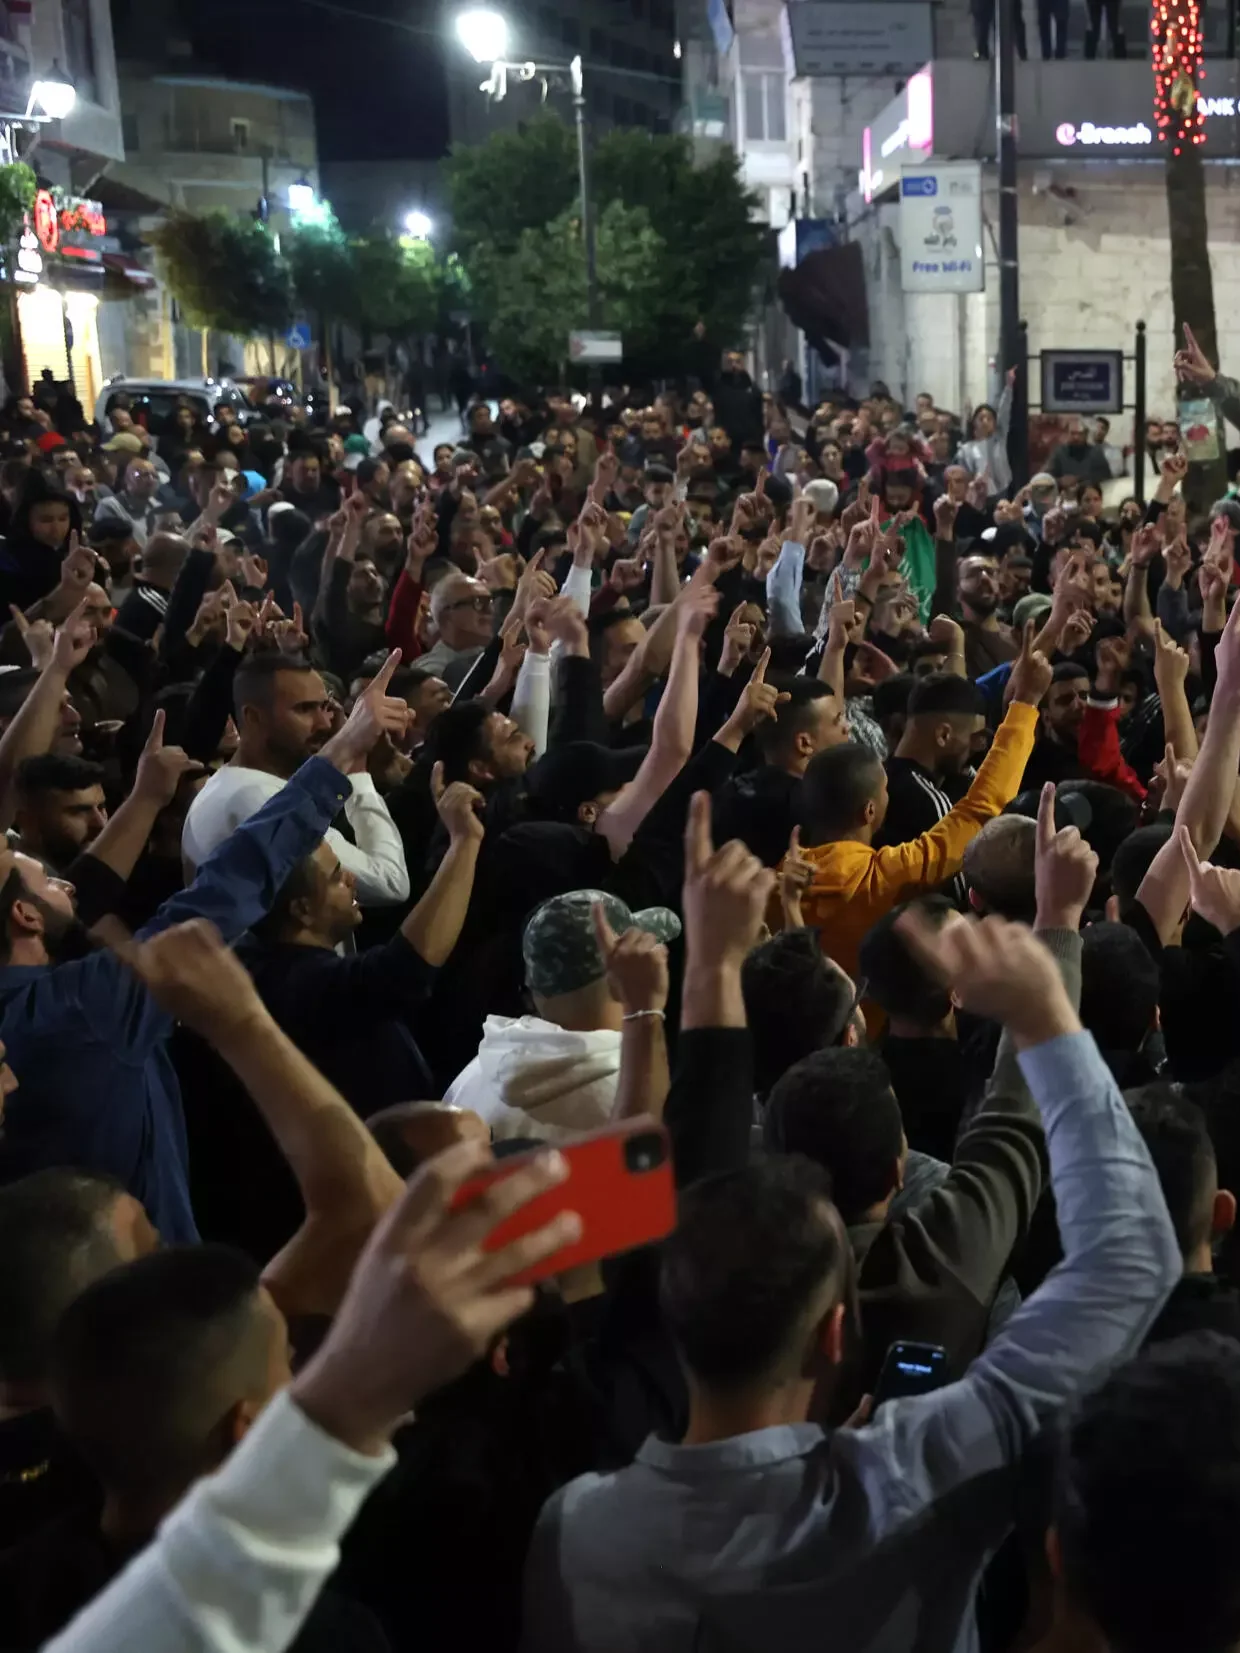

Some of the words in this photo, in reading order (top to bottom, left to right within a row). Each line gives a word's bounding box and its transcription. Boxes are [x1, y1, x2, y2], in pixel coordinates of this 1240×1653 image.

[1196, 96, 1235, 116] ANK
[1056, 121, 1152, 146] e-Branch
[912, 261, 939, 273] Free
